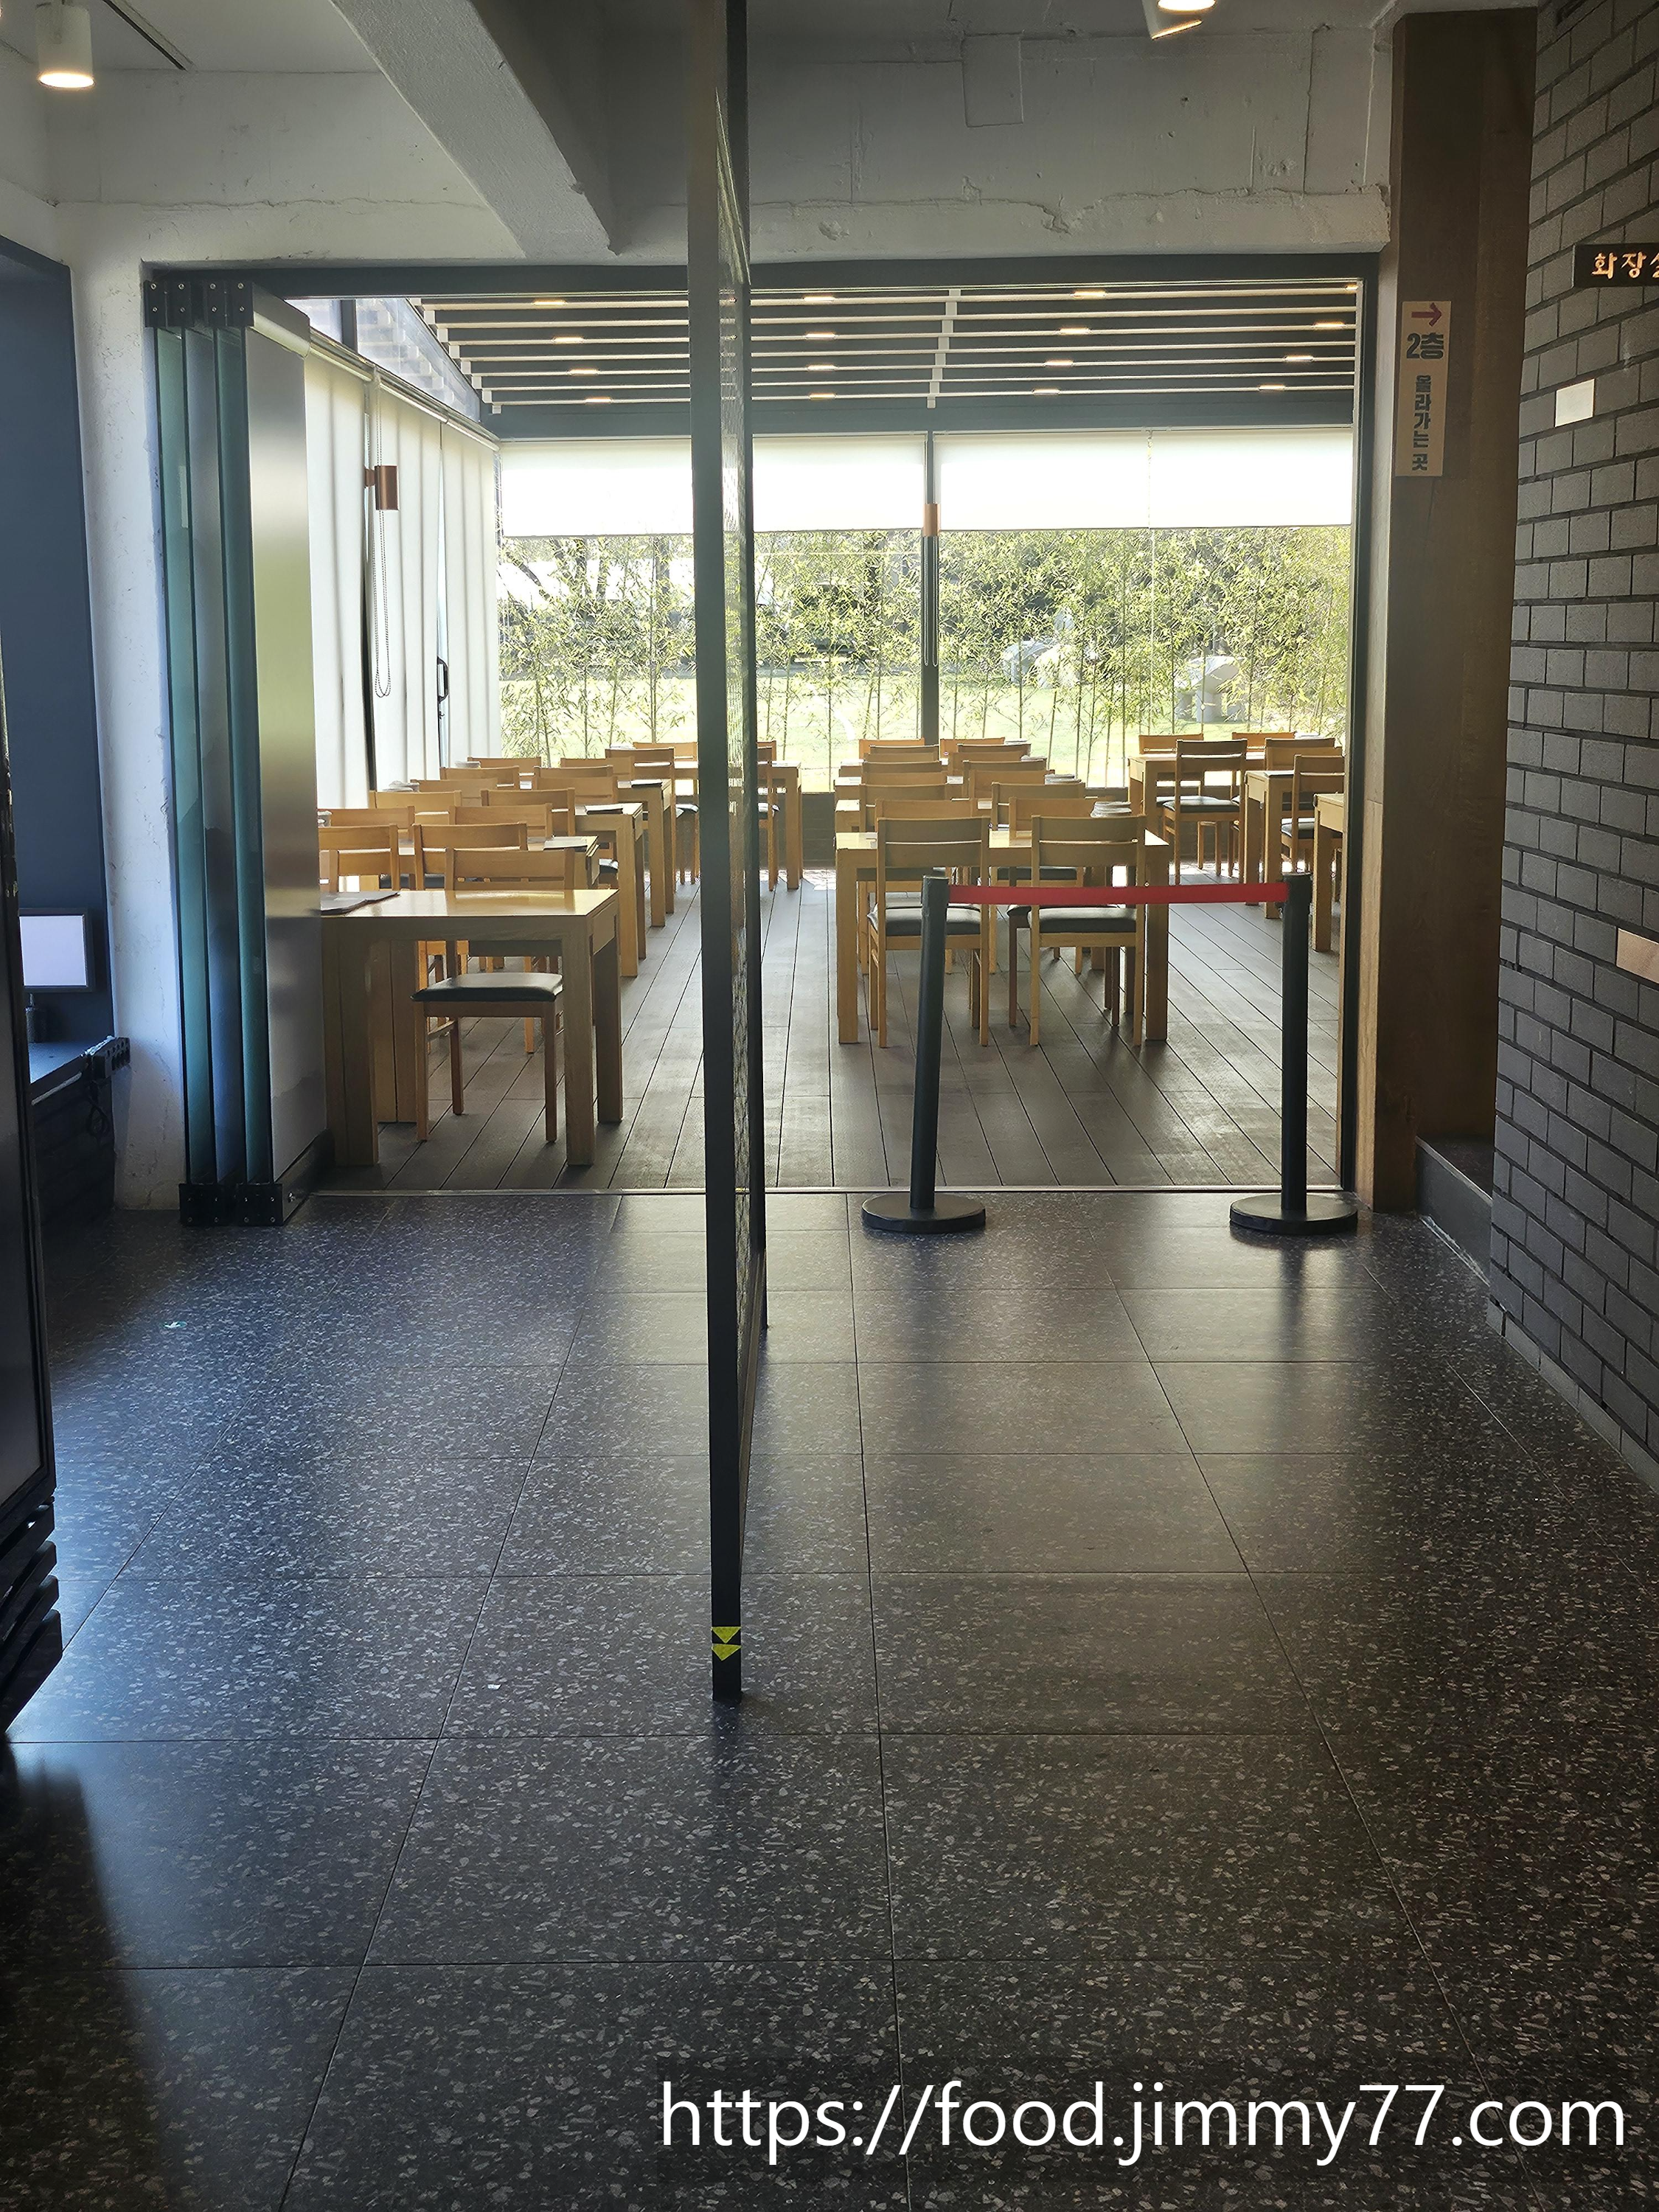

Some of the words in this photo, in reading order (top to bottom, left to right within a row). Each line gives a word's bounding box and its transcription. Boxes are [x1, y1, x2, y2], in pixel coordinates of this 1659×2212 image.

[1406, 333, 1444, 359] 2층
[1413, 375, 1432, 448] 올라가는
[1412, 453, 1428, 470] 곳
